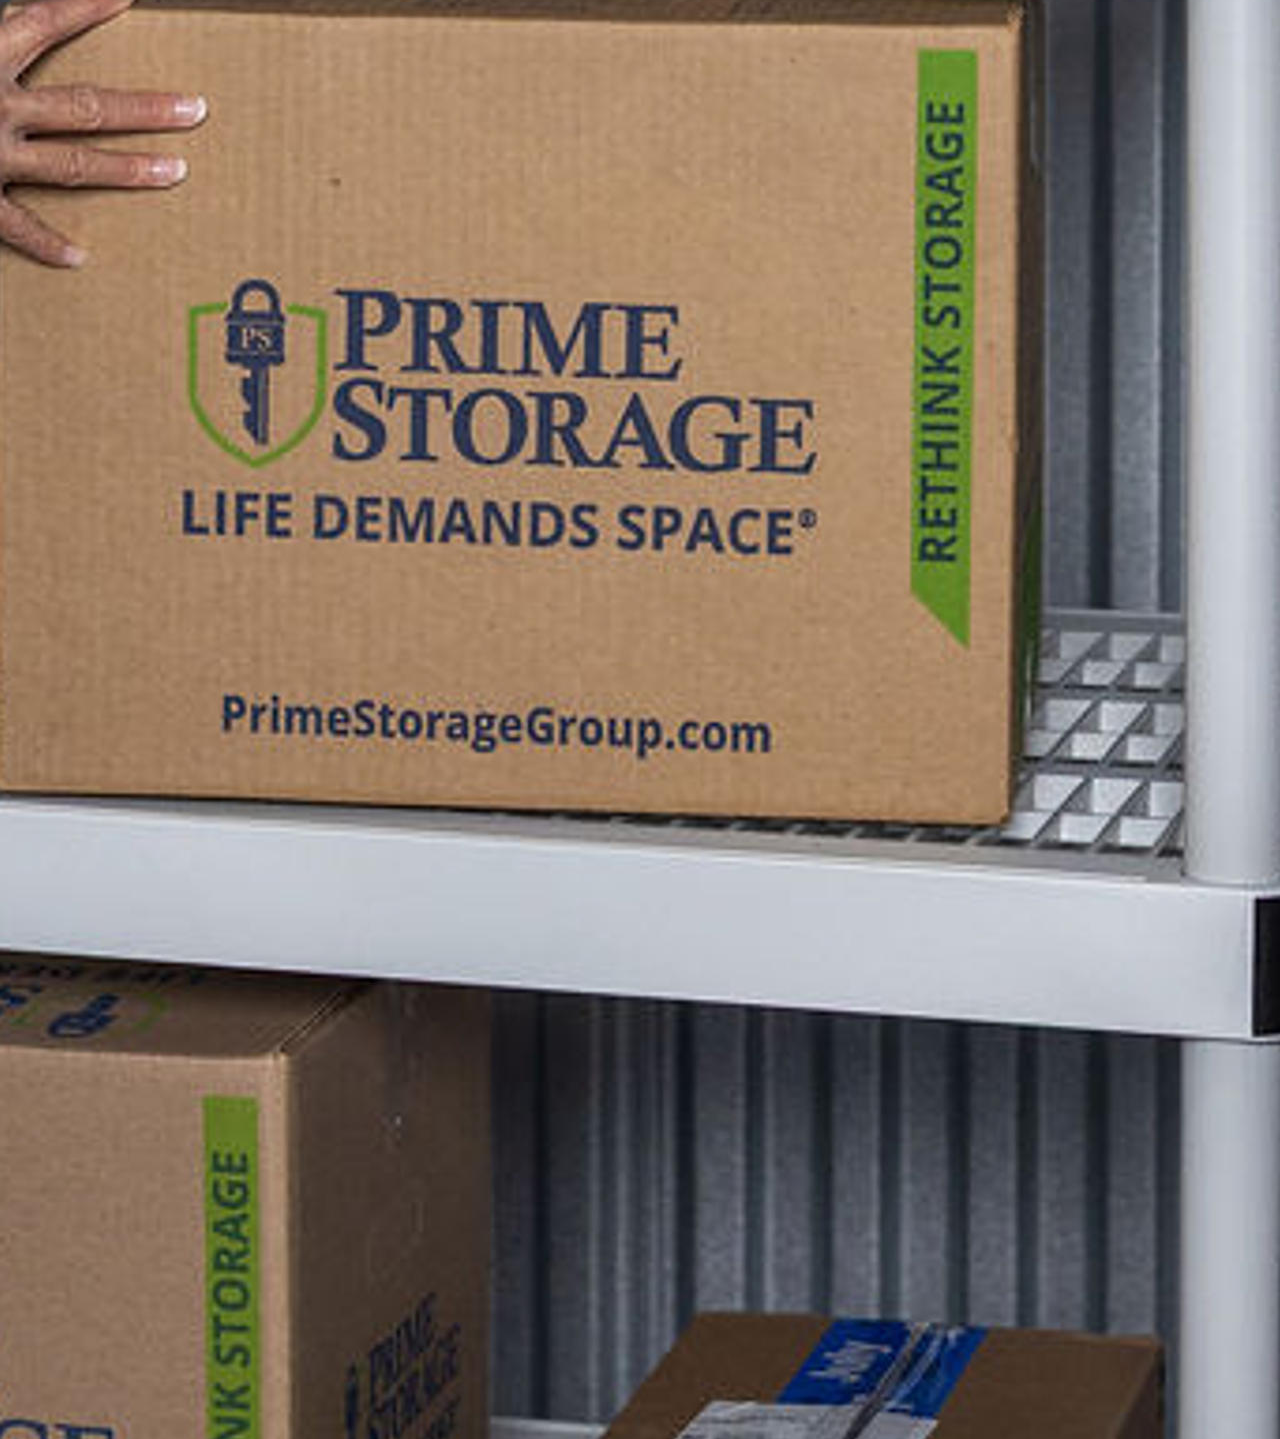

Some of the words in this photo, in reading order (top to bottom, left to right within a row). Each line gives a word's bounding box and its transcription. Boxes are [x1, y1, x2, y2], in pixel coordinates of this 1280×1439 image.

[921, 102, 965, 329] STORAGE
[334, 289, 682, 381] PRIME
[333, 377, 816, 475] STORAGE
[918, 347, 961, 562] RETHINK
[183, 490, 292, 538] LIFE
[313, 495, 599, 549] DEMANDS
[222, 694, 771, 760] PrimeStorageGroup.com
[211, 1151, 251, 1368] STORAGE
